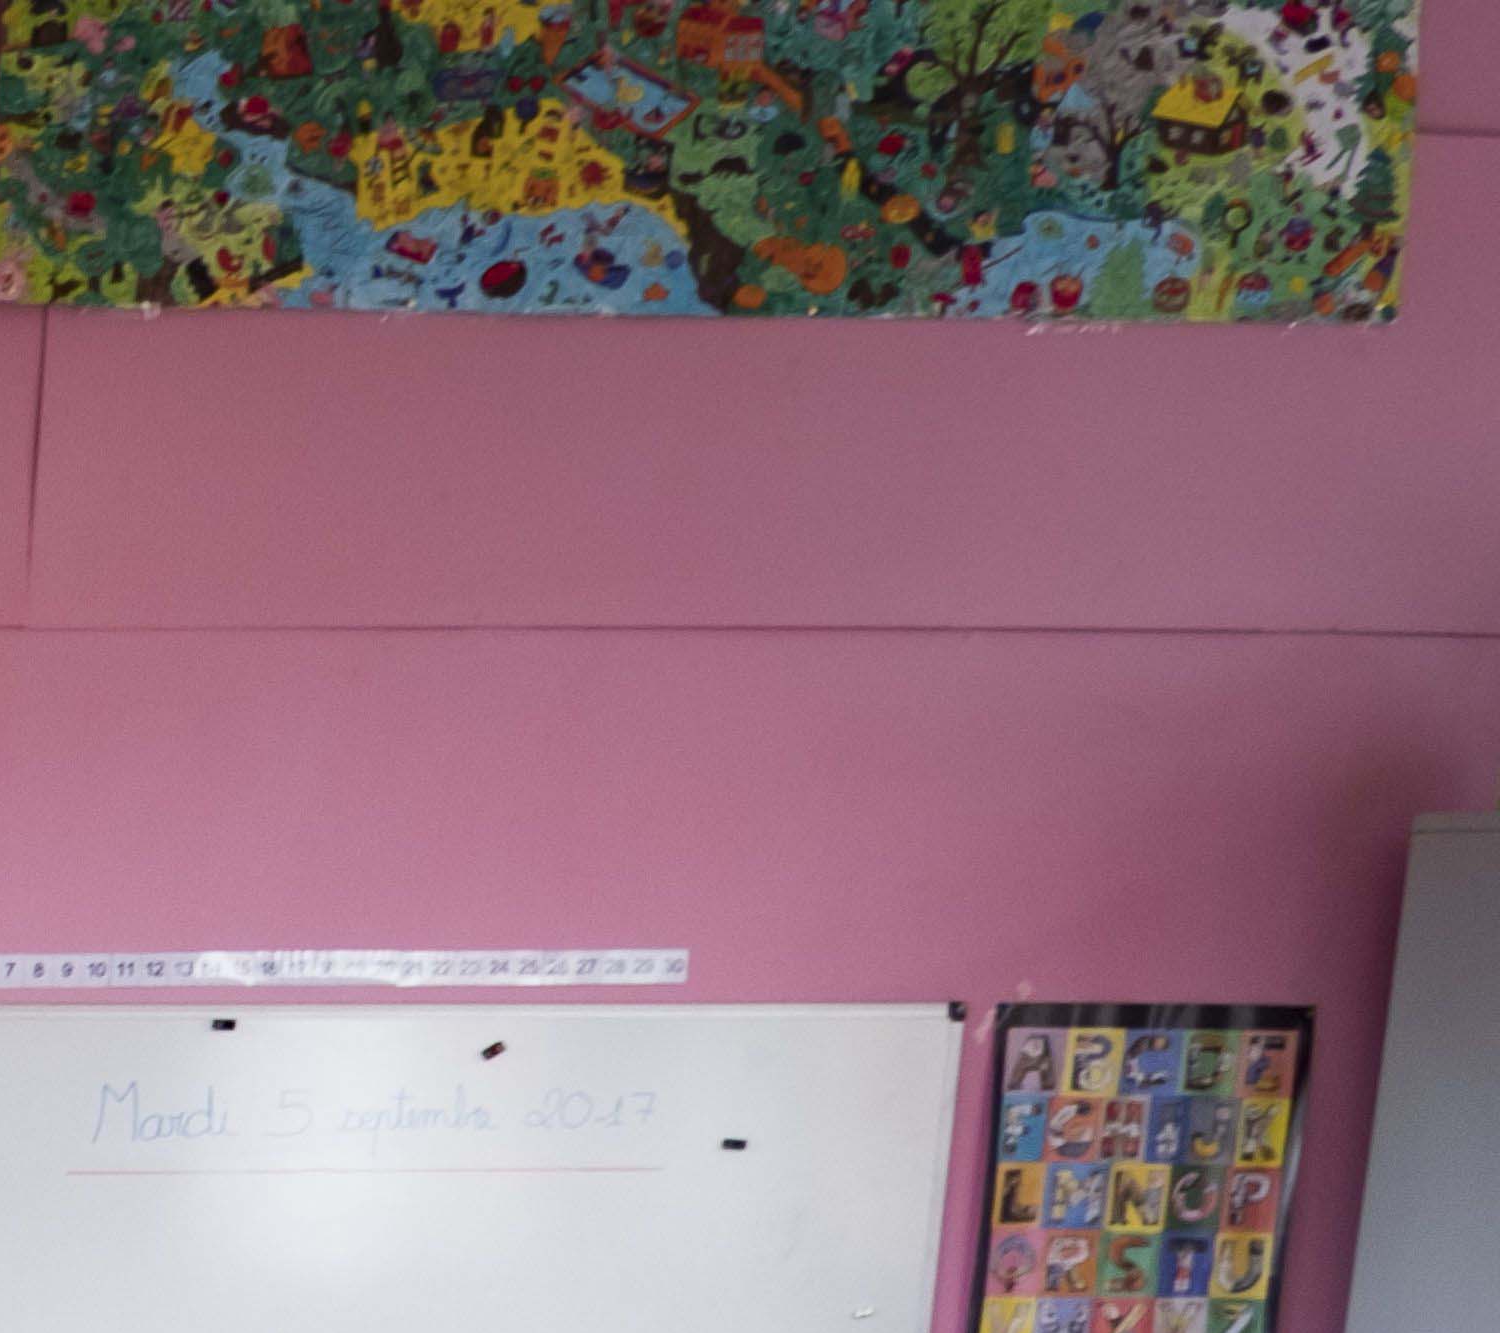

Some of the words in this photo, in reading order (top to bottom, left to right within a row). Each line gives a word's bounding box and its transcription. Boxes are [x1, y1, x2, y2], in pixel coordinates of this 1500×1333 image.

[4, 962, 16, 978] 7
[33, 962, 45, 978] 8
[60, 962, 74, 978] 9
[86, 962, 106, 978] 10
[116, 962, 136, 978] 11
[145, 962, 165, 978] 12
[92, 1080, 232, 1144] Mardi
[264, 1088, 314, 1137] 5
